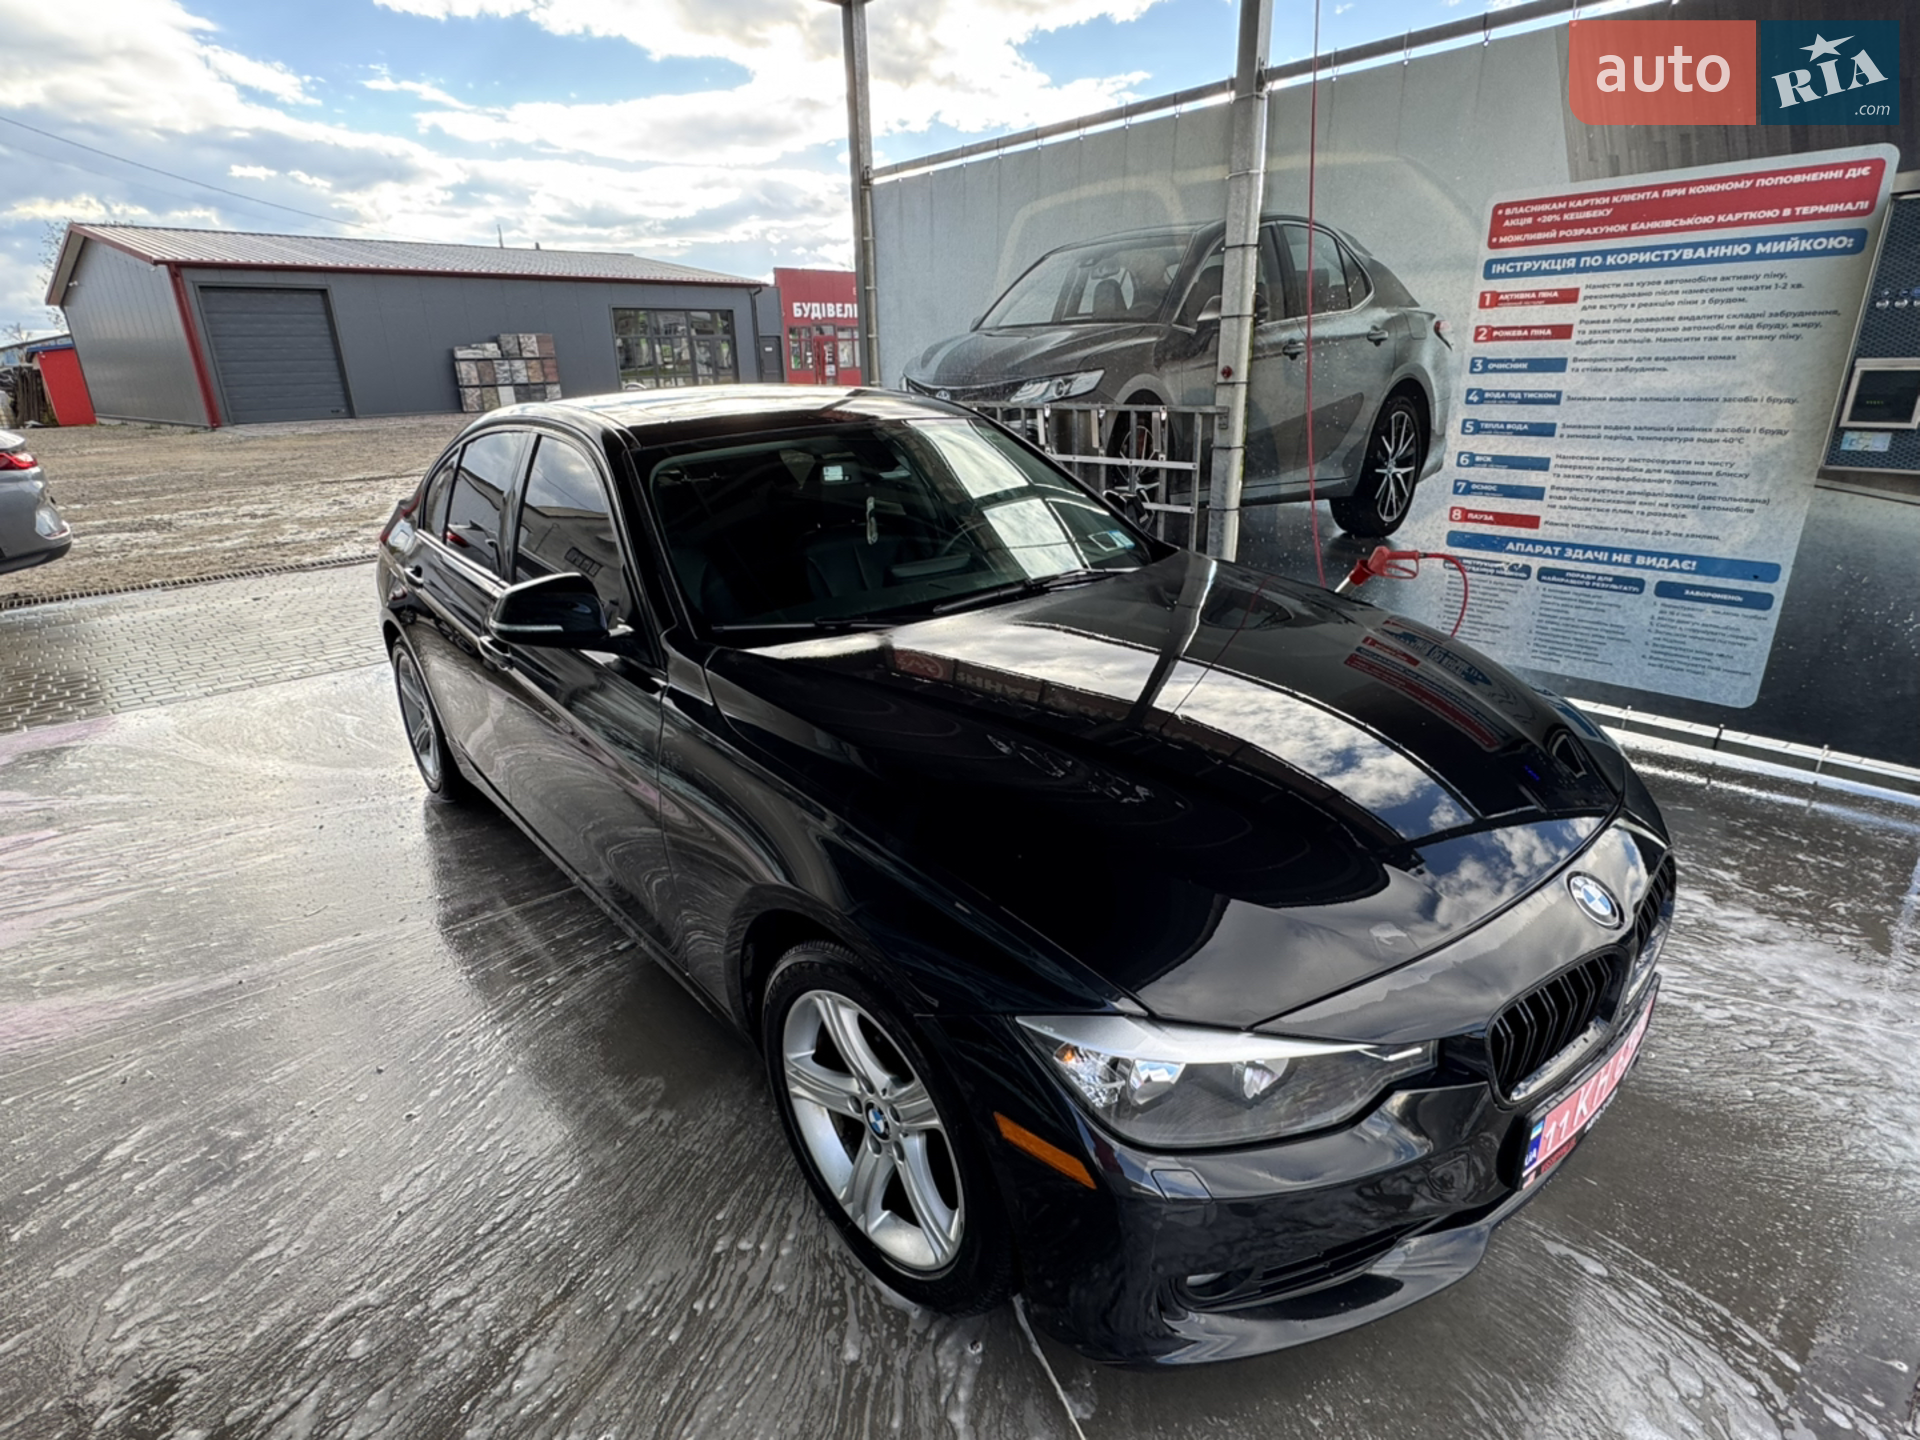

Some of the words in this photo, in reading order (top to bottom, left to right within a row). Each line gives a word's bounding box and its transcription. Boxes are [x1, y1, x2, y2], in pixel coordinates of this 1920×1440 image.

[1505, 201, 1566, 216] ВЛАСНИКАМ
[1568, 196, 1610, 209] КАРТКИ
[1612, 190, 1659, 204] КЛІЄНТА
[1662, 187, 1686, 199] ПРИ
[1688, 179, 1754, 195] КОЖНОМУ
[1756, 169, 1843, 188] ПОПОВНЕННІ
[1845, 166, 1872, 179] ДІЄ
[1499, 228, 1557, 244] МОЖЛИВИЙ
[1559, 223, 1628, 238] РОЗРАХУНОК
[1631, 214, 1715, 232] БАНКІВСЬКОЮ
[1717, 209, 1780, 223] КАРТКОЮ
[1782, 207, 1792, 217] В
[1794, 200, 1870, 216] ТЕРМІНАЛІ
[1503, 216, 1533, 228] АКЦІЯ
[1537, 214, 1561, 223] +20%
[1563, 208, 1614, 221] КЕШБЕКУ
[1491, 258, 1576, 274] ІНСТРУКЦІЯ
[1580, 255, 1601, 268] ПО
[1606, 242, 1751, 266] КОРИСТУВАННЮ
[1755, 236, 1855, 255] МИЙКОЮ:
[1484, 293, 1491, 306] 1
[1477, 327, 1488, 341] 2
[1472, 359, 1483, 372] 3
[1467, 390, 1480, 403] 4
[1464, 421, 1475, 433] 5
[1460, 453, 1470, 466] 6
[1456, 482, 1467, 494] 7
[1451, 508, 1462, 521] 8
[1505, 541, 1562, 557] АПАРАТ
[1563, 547, 1608, 562] ЗДАЧІ
[1611, 553, 1632, 564] НЕ
[1635, 555, 1697, 571] ВИДАЄ!
